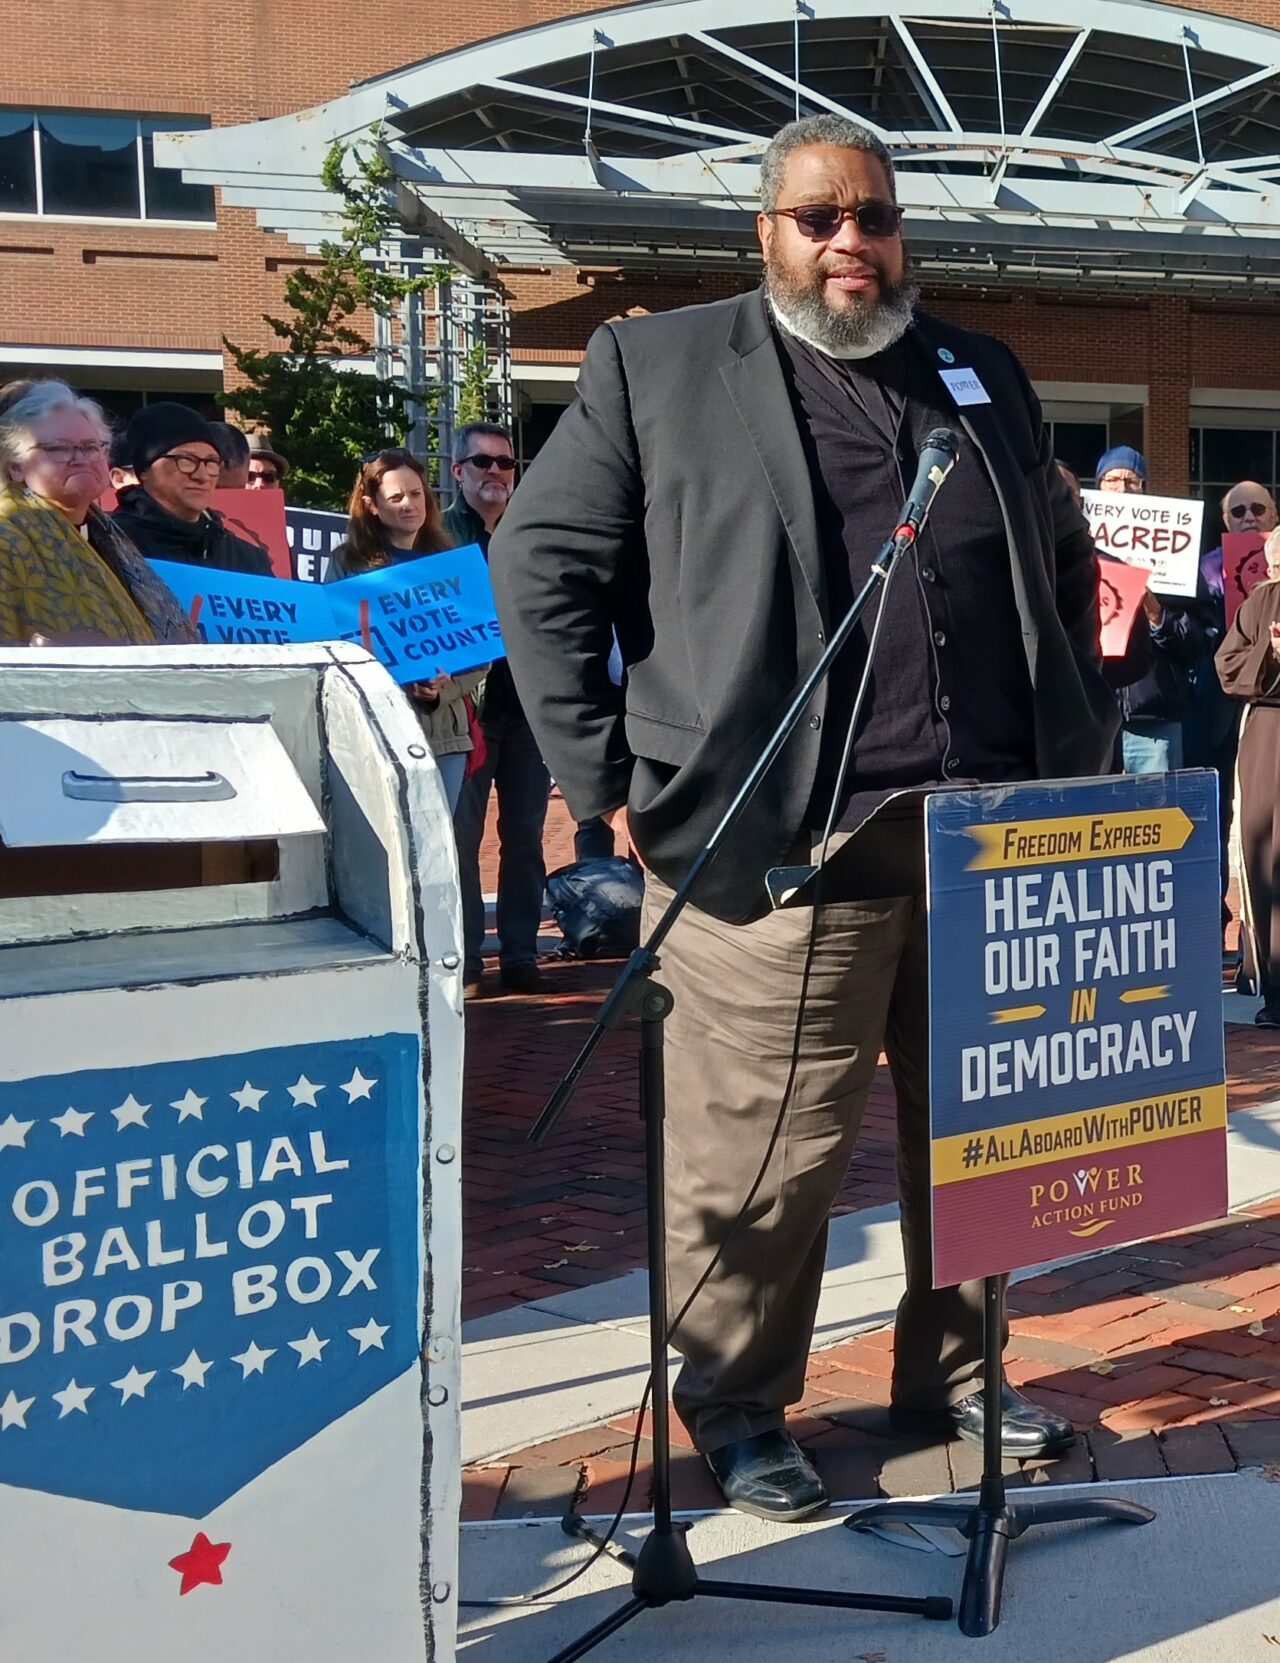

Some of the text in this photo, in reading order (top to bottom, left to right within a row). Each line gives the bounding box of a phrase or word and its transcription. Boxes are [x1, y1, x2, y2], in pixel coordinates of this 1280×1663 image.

[1085, 503, 1193, 526] VERY VOTE IS
[1094, 522, 1192, 554] ACRED
[207, 593, 297, 623] EVERY
[378, 576, 462, 615] EVERY
[216, 624, 290, 645] VOTE
[388, 604, 461, 638] VOTE
[403, 620, 501, 661] COUNTS
[984, 859, 1174, 934] HEALING
[984, 918, 1176, 995] OUR FAITH
[1071, 987, 1096, 1024] IN
[961, 1011, 1198, 1103] DEMOCRACY
[12, 1131, 349, 1227] OFFICIAL
[1029, 1164, 1144, 1208] POWER
[1031, 1192, 1143, 1229] ACTION FUND
[42, 1194, 332, 1287] BALLOT
[0, 1248, 381, 1364] DROP BOX
